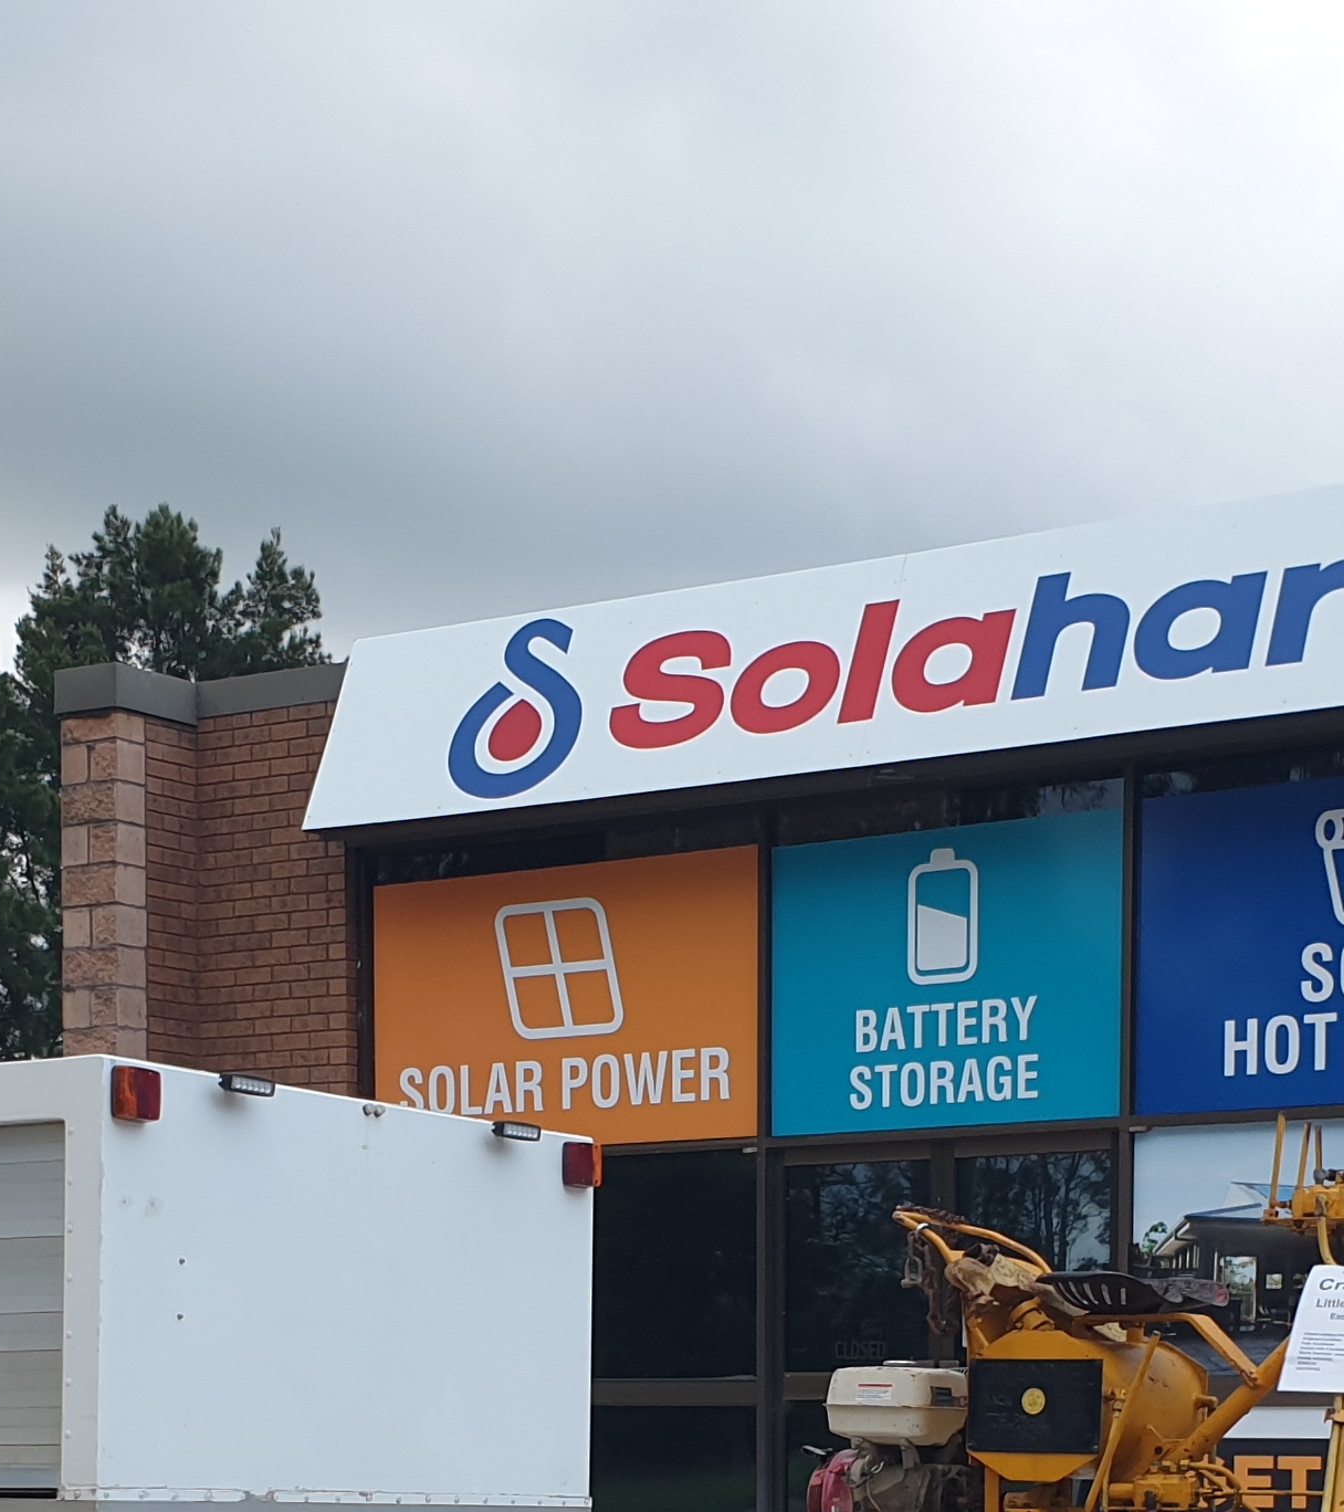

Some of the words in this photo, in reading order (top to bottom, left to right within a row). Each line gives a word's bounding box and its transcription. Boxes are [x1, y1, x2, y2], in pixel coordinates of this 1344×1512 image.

[855, 995, 1038, 1053] BATTERY
[1223, 1012, 1338, 1077] HOT
[399, 1060, 544, 1115] SOLAR
[561, 1047, 731, 1110] POWER
[849, 1054, 1040, 1111] STORAGE
